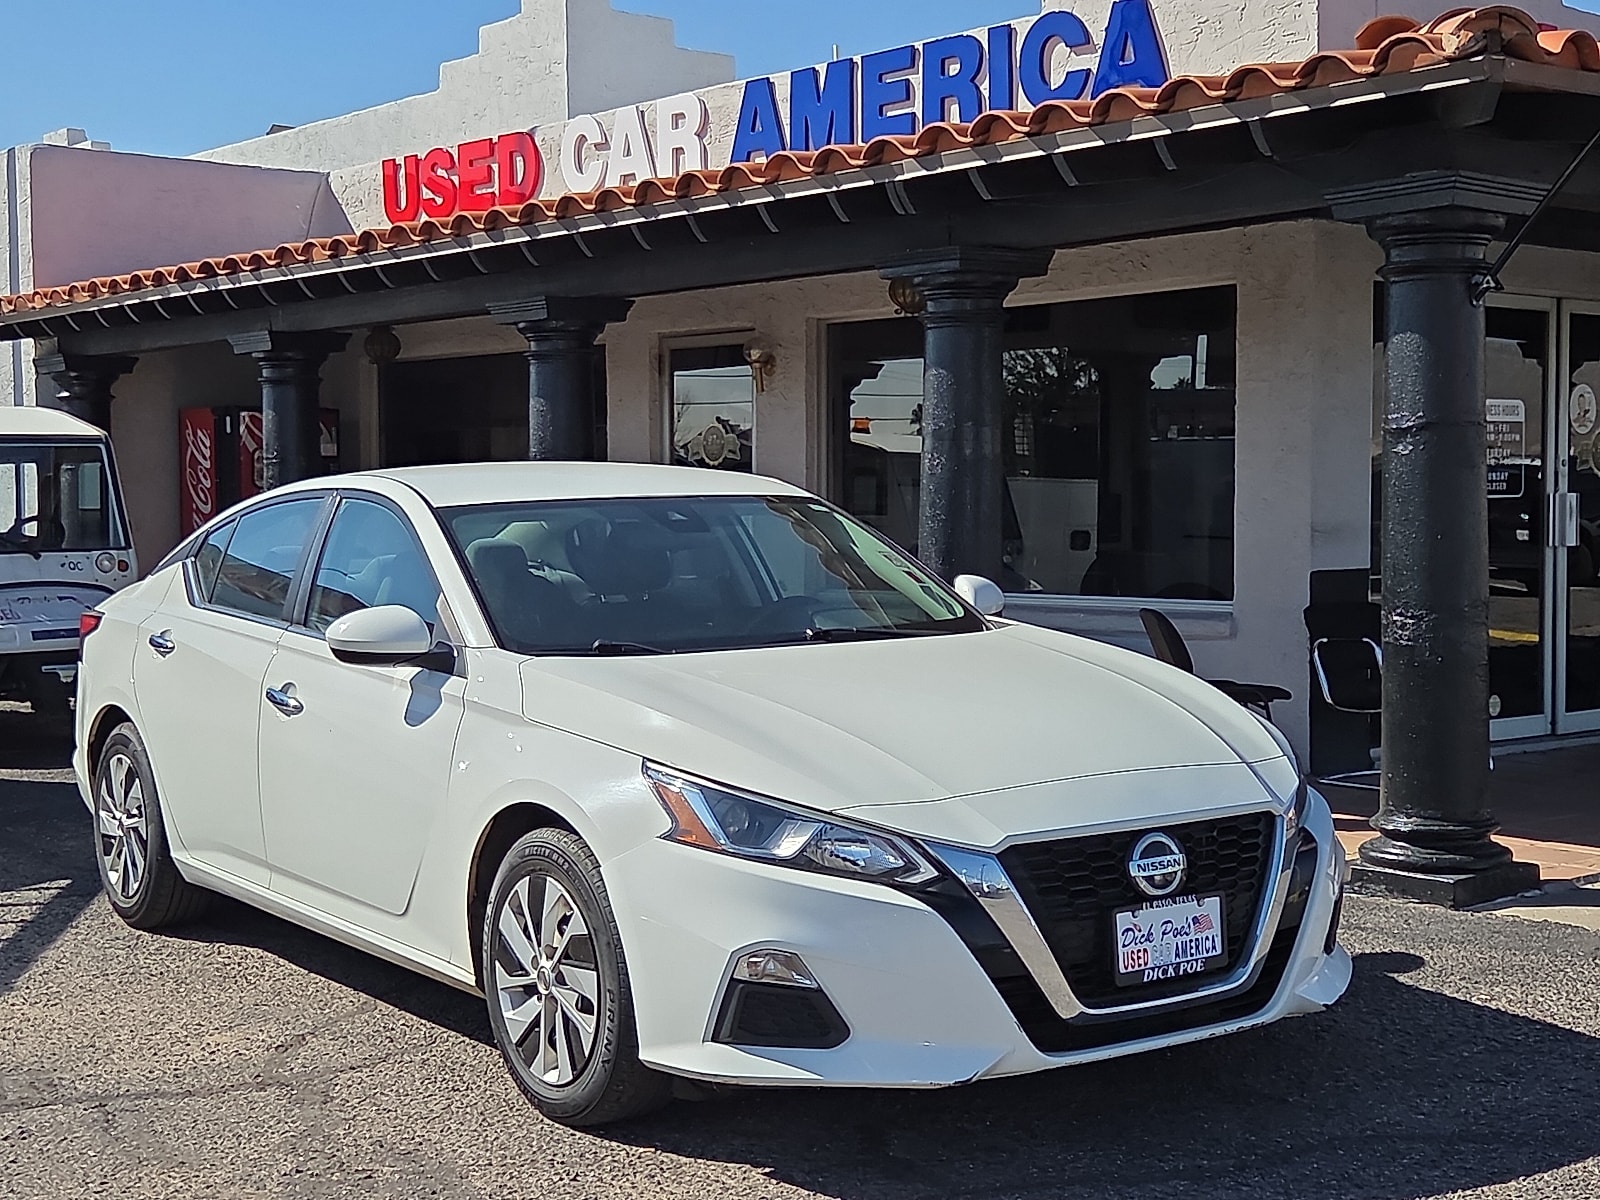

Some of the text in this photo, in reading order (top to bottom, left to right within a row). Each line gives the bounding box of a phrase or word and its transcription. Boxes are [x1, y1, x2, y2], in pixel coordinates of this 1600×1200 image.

[381, 0, 1170, 223] USED CAR AMERICA
[1136, 857, 1181, 874] NISSAN
[1121, 916, 1192, 949] Dick Poe's
[1122, 947, 1149, 971] USED
[1174, 935, 1218, 961] AMERICA
[1143, 959, 1206, 983] DICK POE
